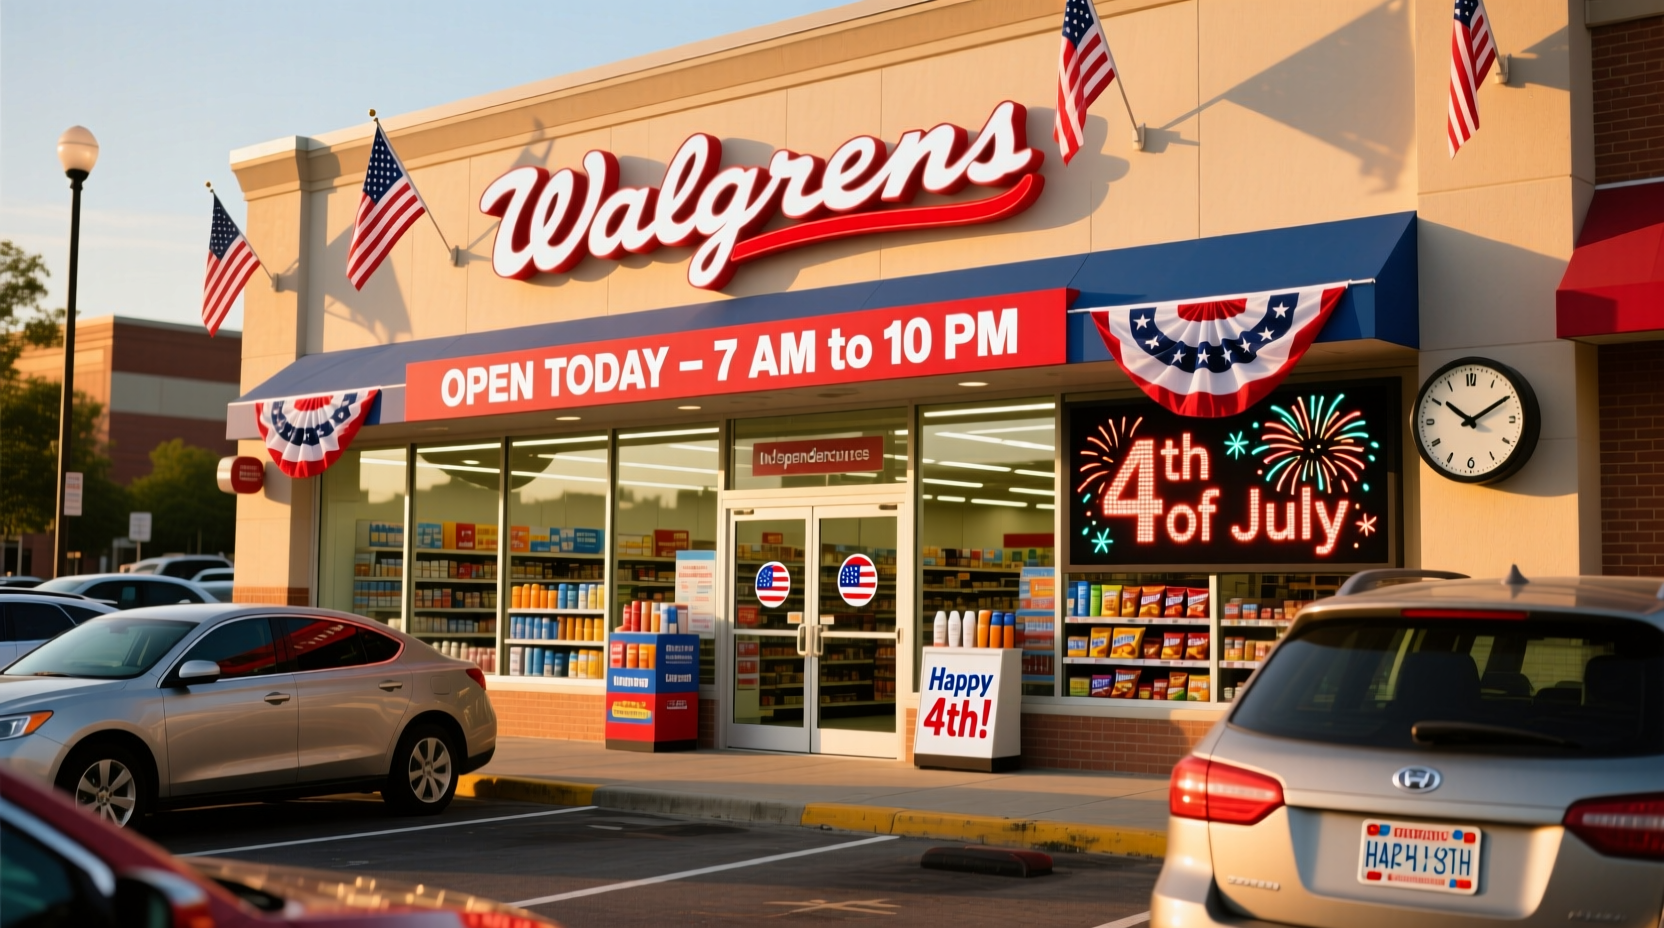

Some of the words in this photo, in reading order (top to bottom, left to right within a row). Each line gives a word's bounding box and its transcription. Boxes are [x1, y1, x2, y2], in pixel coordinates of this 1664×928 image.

[480, 100, 1043, 290] Walgrens
[440, 361, 534, 407] OPEN
[545, 346, 669, 397] TODAY
[714, 338, 738, 381] 7
[749, 329, 816, 379] AM
[828, 328, 873, 371] to
[883, 317, 932, 364] 10
[945, 307, 1018, 360] PM
[1102, 432, 1210, 544] 4th
[1165, 487, 1220, 543] of
[1230, 486, 1349, 556] July
[923, 697, 992, 739] 4th!
[928, 666, 994, 697] Happy
